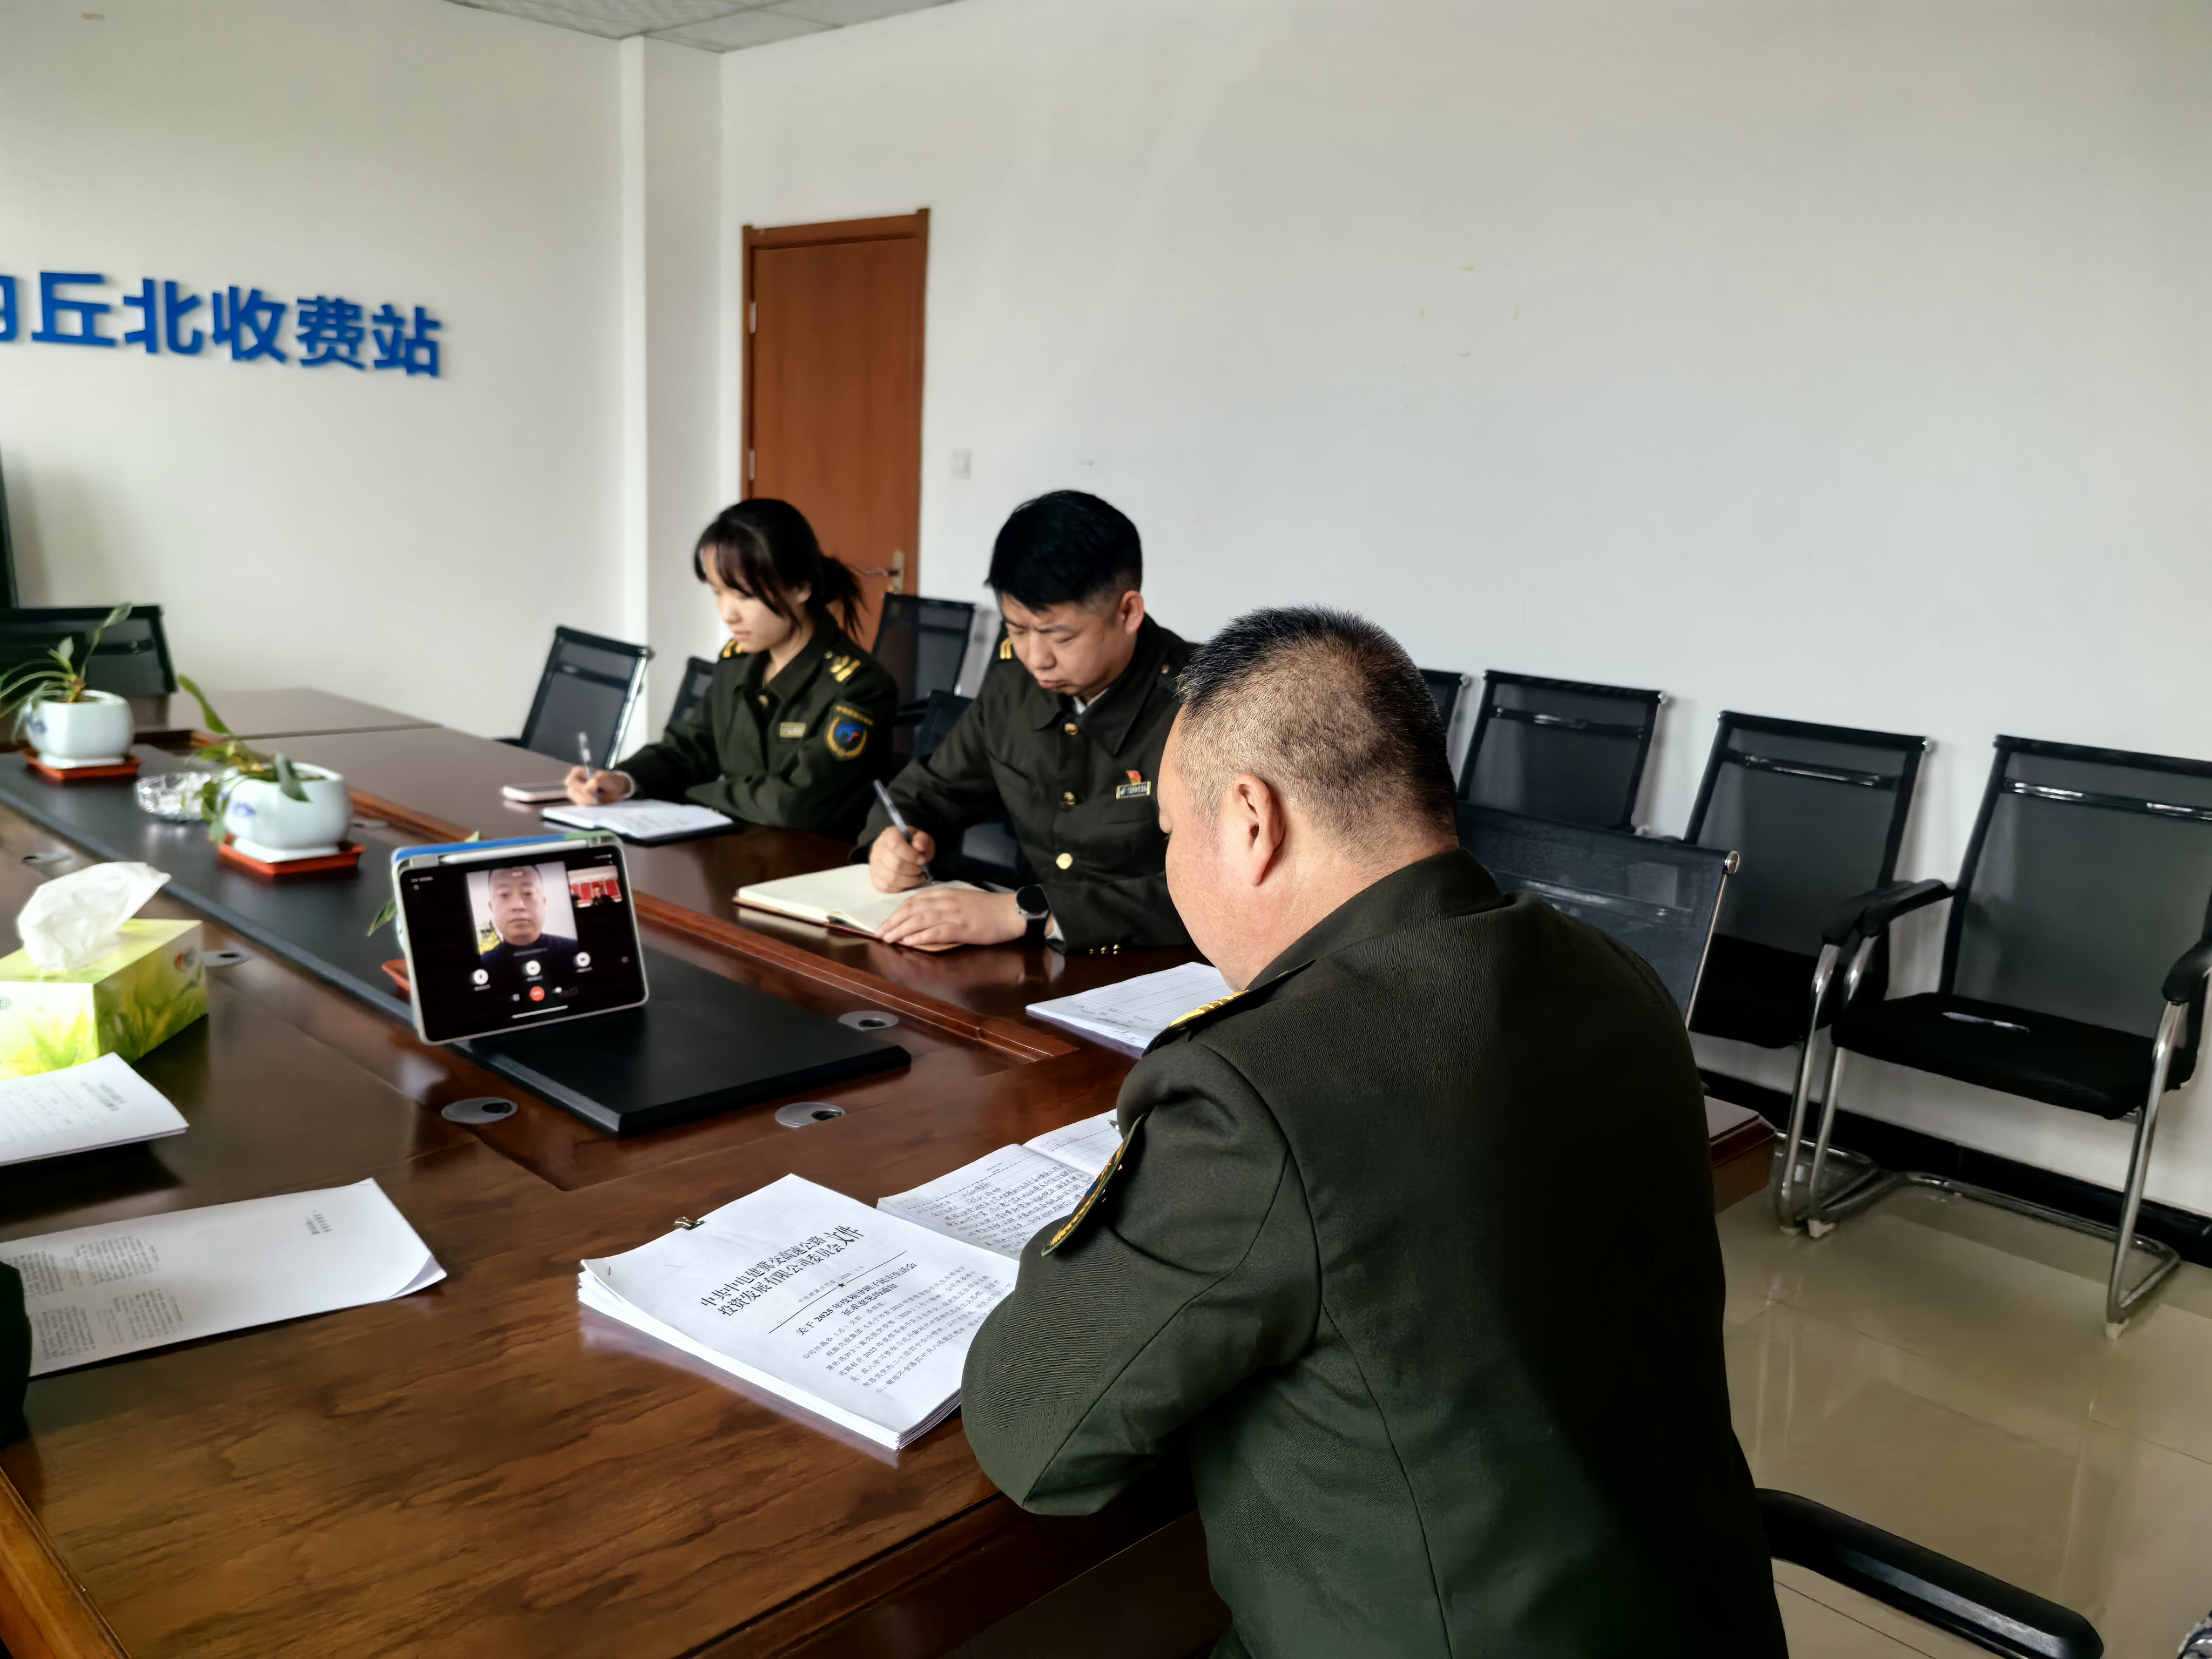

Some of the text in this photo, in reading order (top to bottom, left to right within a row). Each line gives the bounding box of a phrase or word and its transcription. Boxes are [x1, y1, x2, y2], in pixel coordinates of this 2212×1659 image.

[0, 272, 441, 376] 丘北收费站
[823, 1225, 865, 1246] 文件
[700, 1236, 827, 1306] 中共中电建冀交高速公路
[717, 1244, 845, 1316] 投资发展有限公司委员会
[841, 1283, 899, 1316] 征求意见的通知
